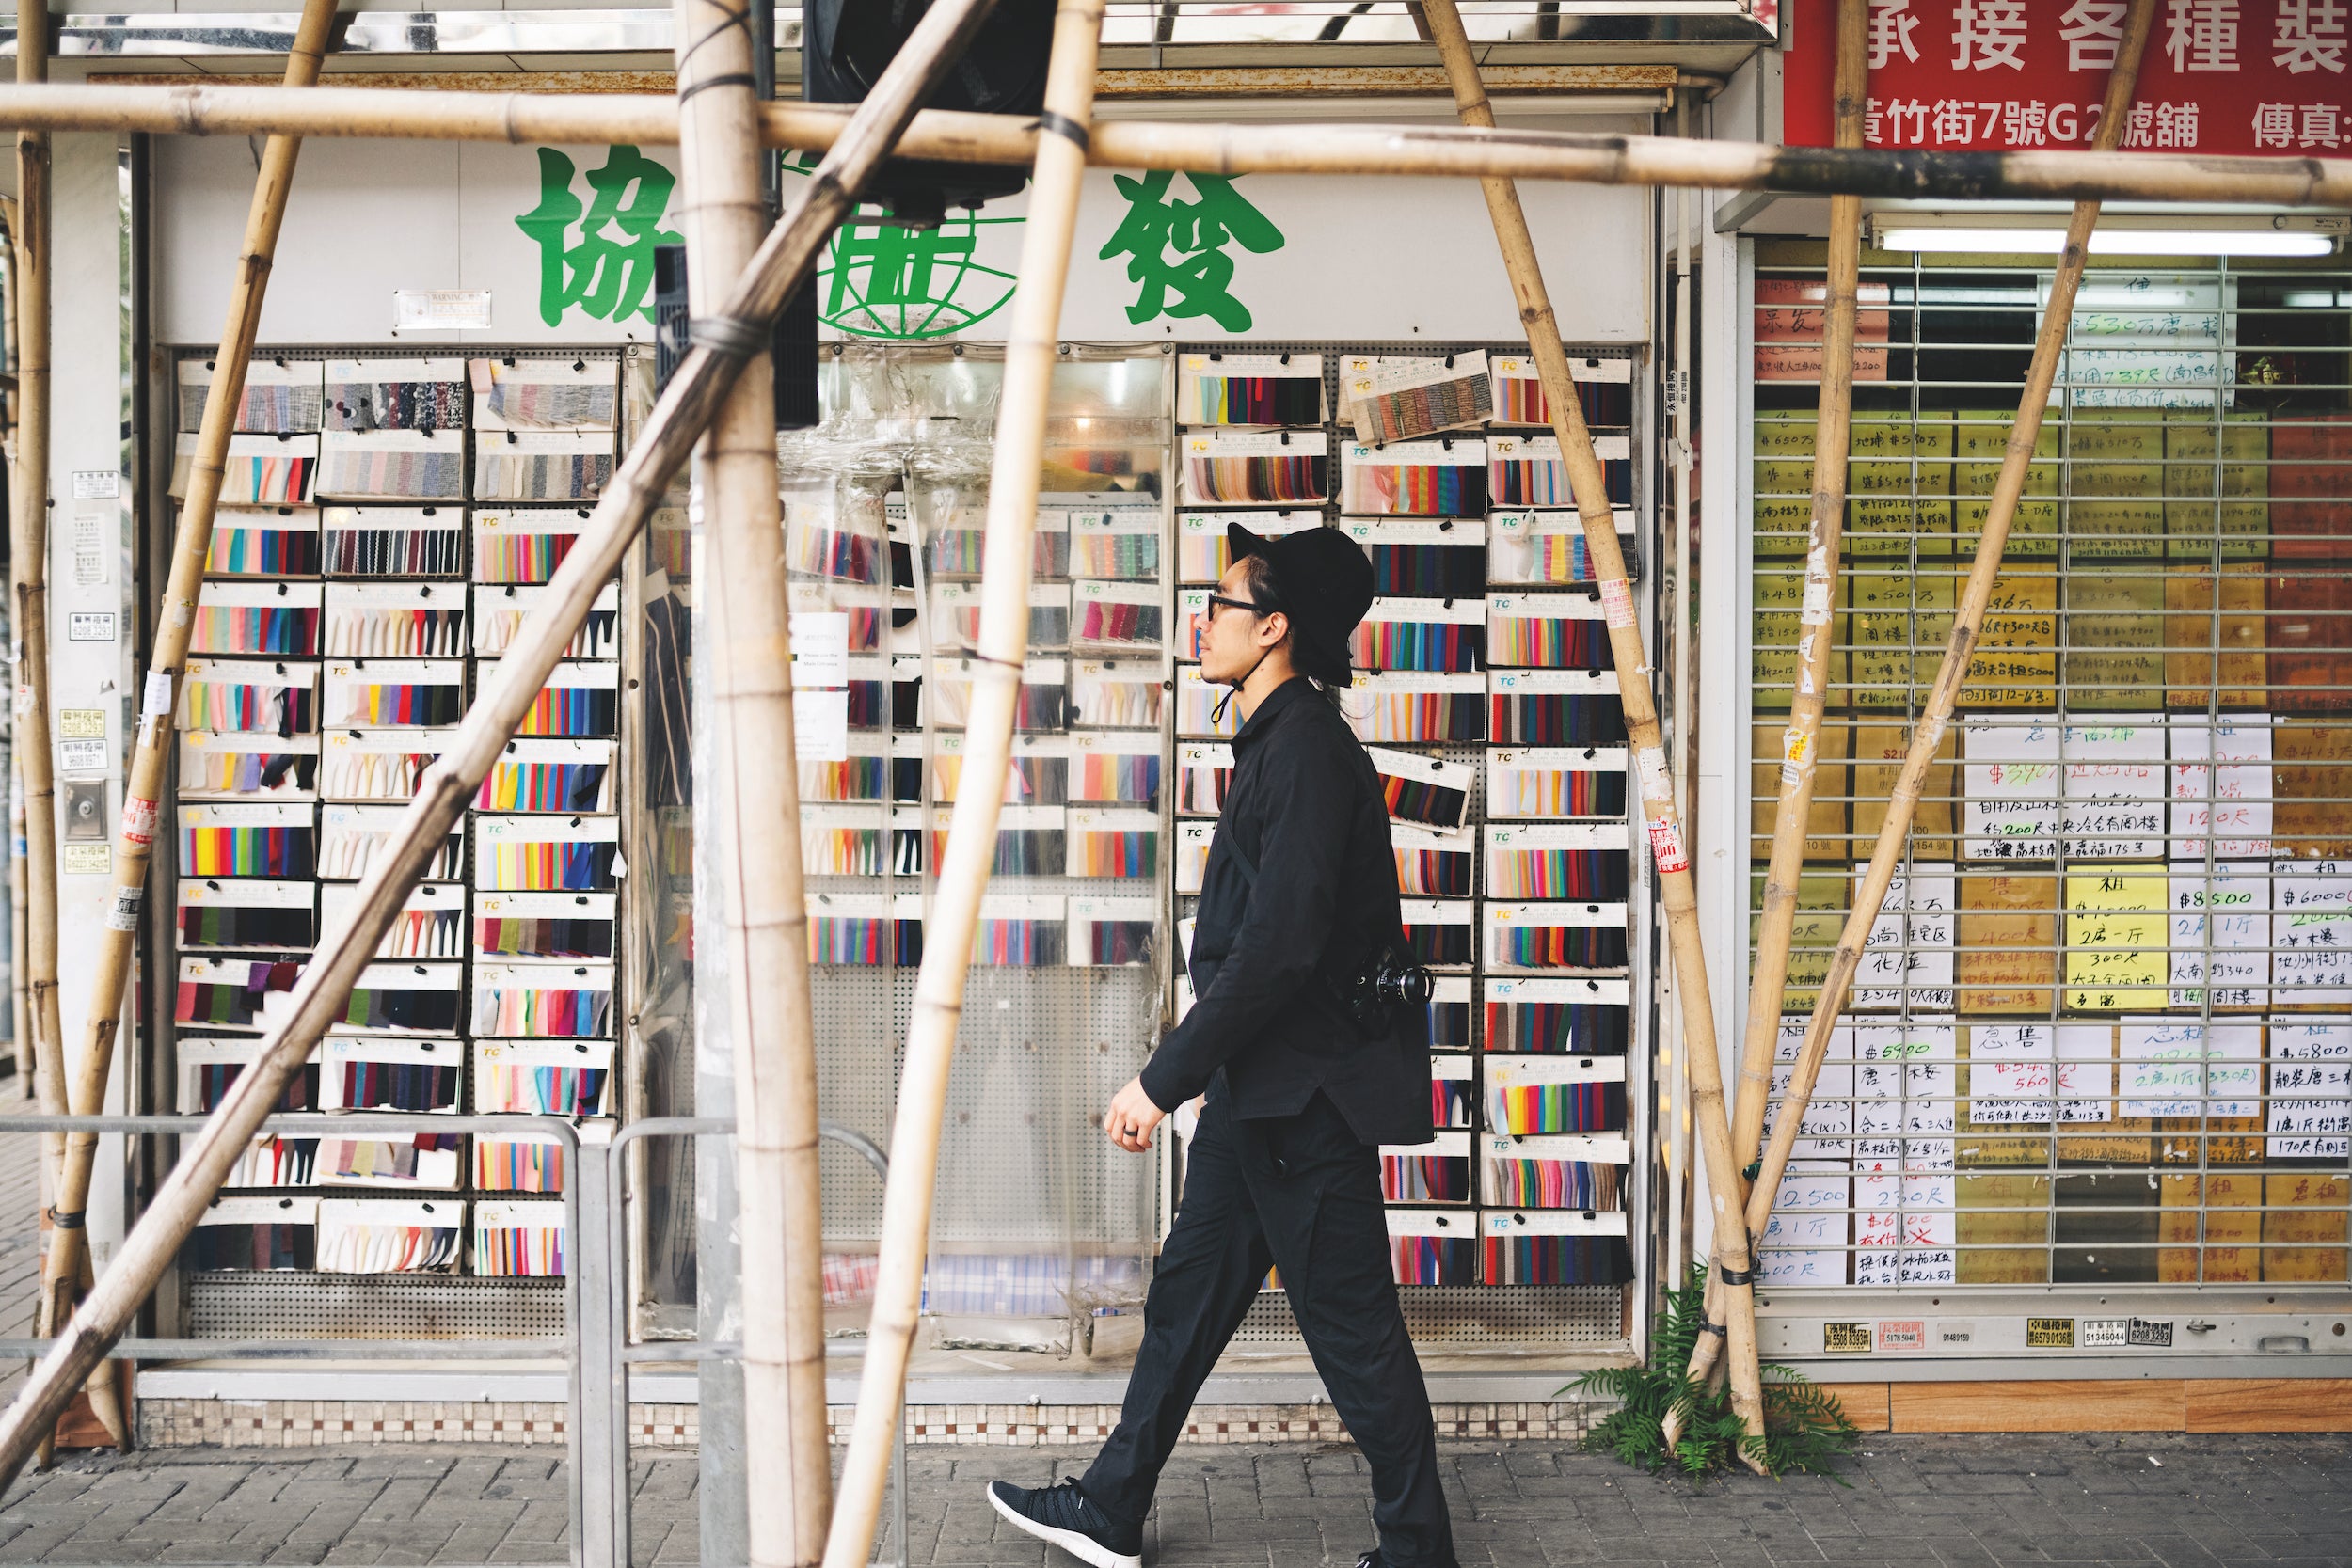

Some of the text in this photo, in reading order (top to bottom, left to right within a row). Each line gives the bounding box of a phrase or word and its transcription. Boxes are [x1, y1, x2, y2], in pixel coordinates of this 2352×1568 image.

[2250, 102, 2352, 149] 傳真:
[1502, 361, 1517, 370] TC
[1356, 381, 1370, 390] TC
[1192, 442, 1207, 451] TC
[482, 517, 498, 526] TC
[660, 513, 674, 522] TC
[1080, 516, 1095, 526] TC
[1188, 518, 1203, 527] TC
[1353, 527, 1368, 535] TC
[942, 588, 957, 597] TC
[1084, 584, 1100, 594] TC
[1187, 595, 1202, 604] TC
[1495, 599, 1510, 608] TC
[186, 665, 201, 673] TC
[1083, 664, 1097, 673] TC
[1500, 677, 1515, 686] TC
[333, 736, 348, 745] TC
[943, 738, 959, 748] TC
[1077, 736, 1092, 747] TC
[1497, 753, 1512, 762] TC
[330, 814, 345, 822] TC
[1076, 814, 1090, 823] TC
[2098, 869, 2128, 893] 租
[484, 901, 499, 910] TC
[1496, 911, 1511, 919] TC
[483, 972, 498, 980] TC
[333, 1043, 348, 1052] TC
[1494, 1219, 1508, 1227] TC
[1943, 1334, 1970, 1342] 91489159
[2132, 1330, 2150, 1340] 6208
